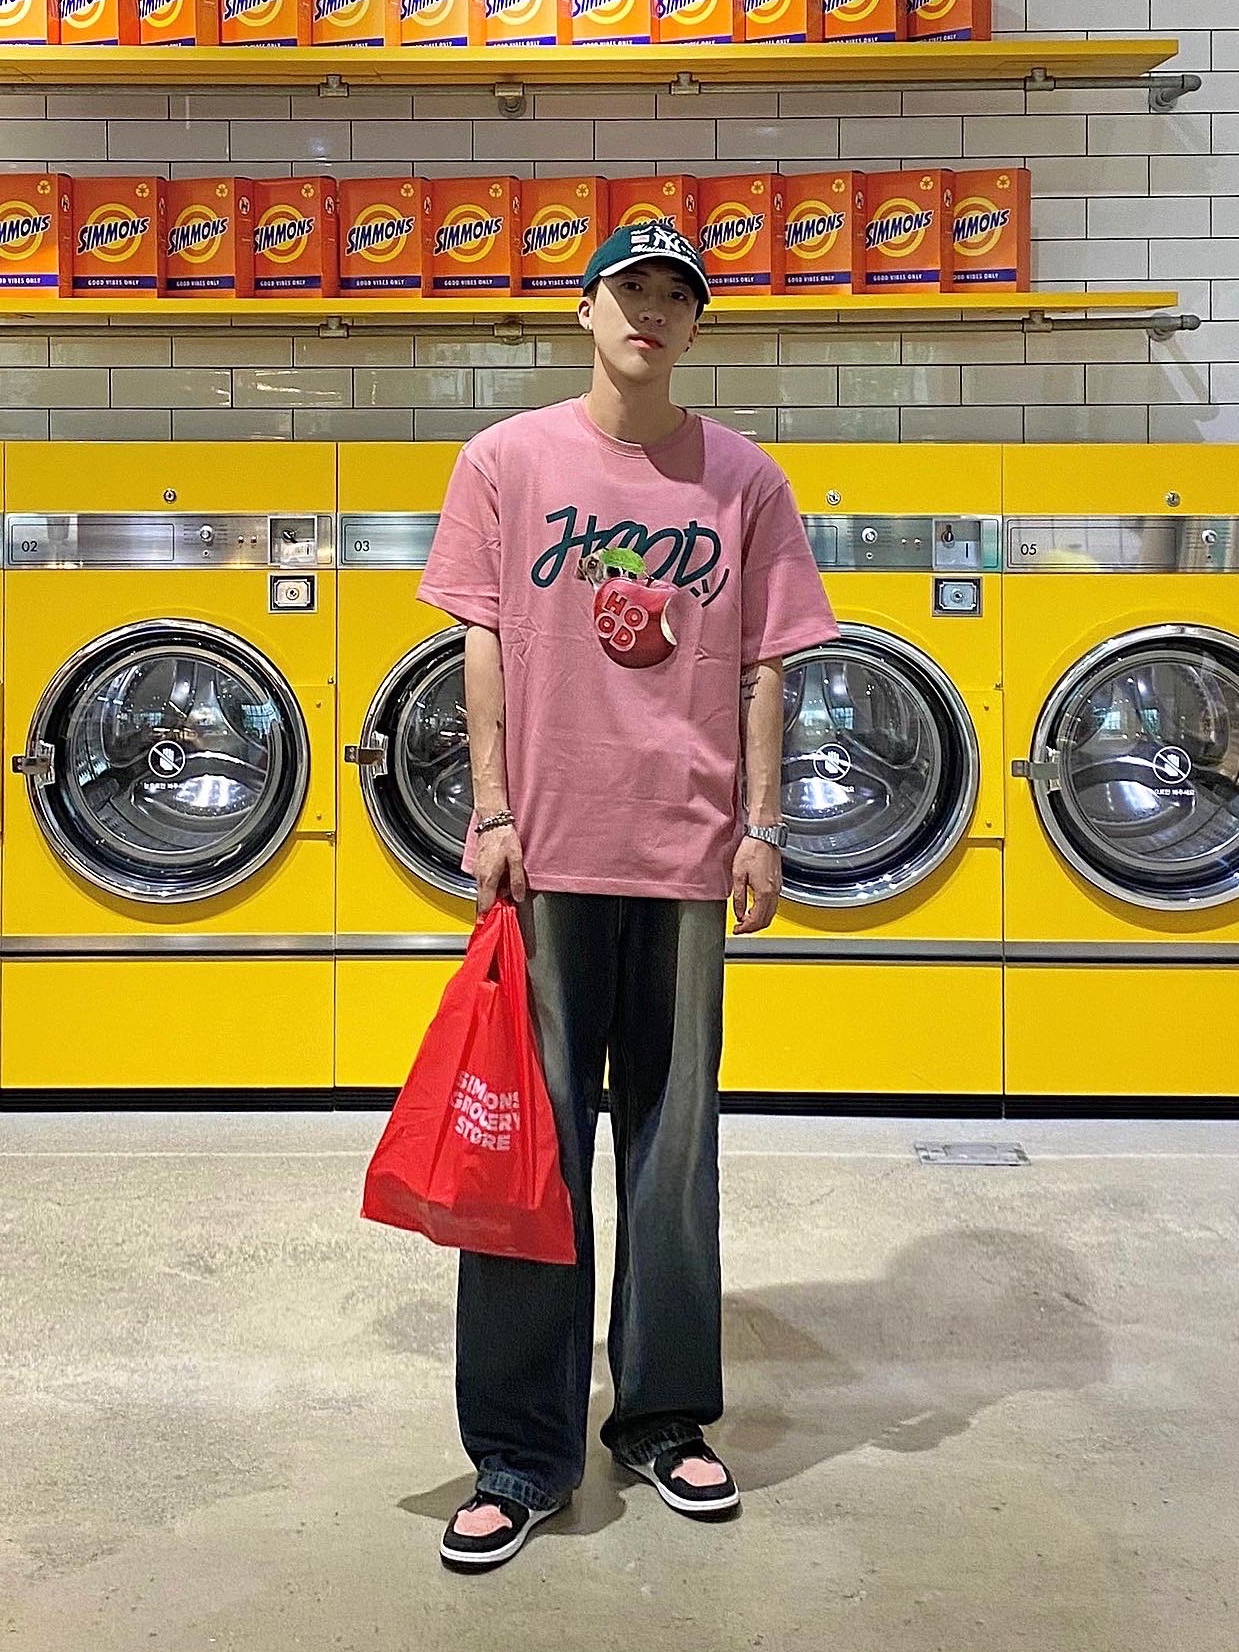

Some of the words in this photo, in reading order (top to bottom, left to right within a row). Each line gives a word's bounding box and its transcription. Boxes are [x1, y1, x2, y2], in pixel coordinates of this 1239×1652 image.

[77, 217, 150, 255] SIMMONS
[167, 217, 229, 257] SIMMONS
[345, 217, 415, 256] SIMMONS
[433, 217, 504, 256] SIMMONS
[521, 216, 591, 256] SIMMONS
[699, 213, 765, 254] SIMMONS
[865, 210, 934, 250] SIMMONS
[953, 209, 1011, 245] MMONS
[21, 540, 38, 552] 02
[354, 540, 370, 552] 03
[1020, 543, 1037, 556] 05
[455, 1115, 511, 1151] STORE
